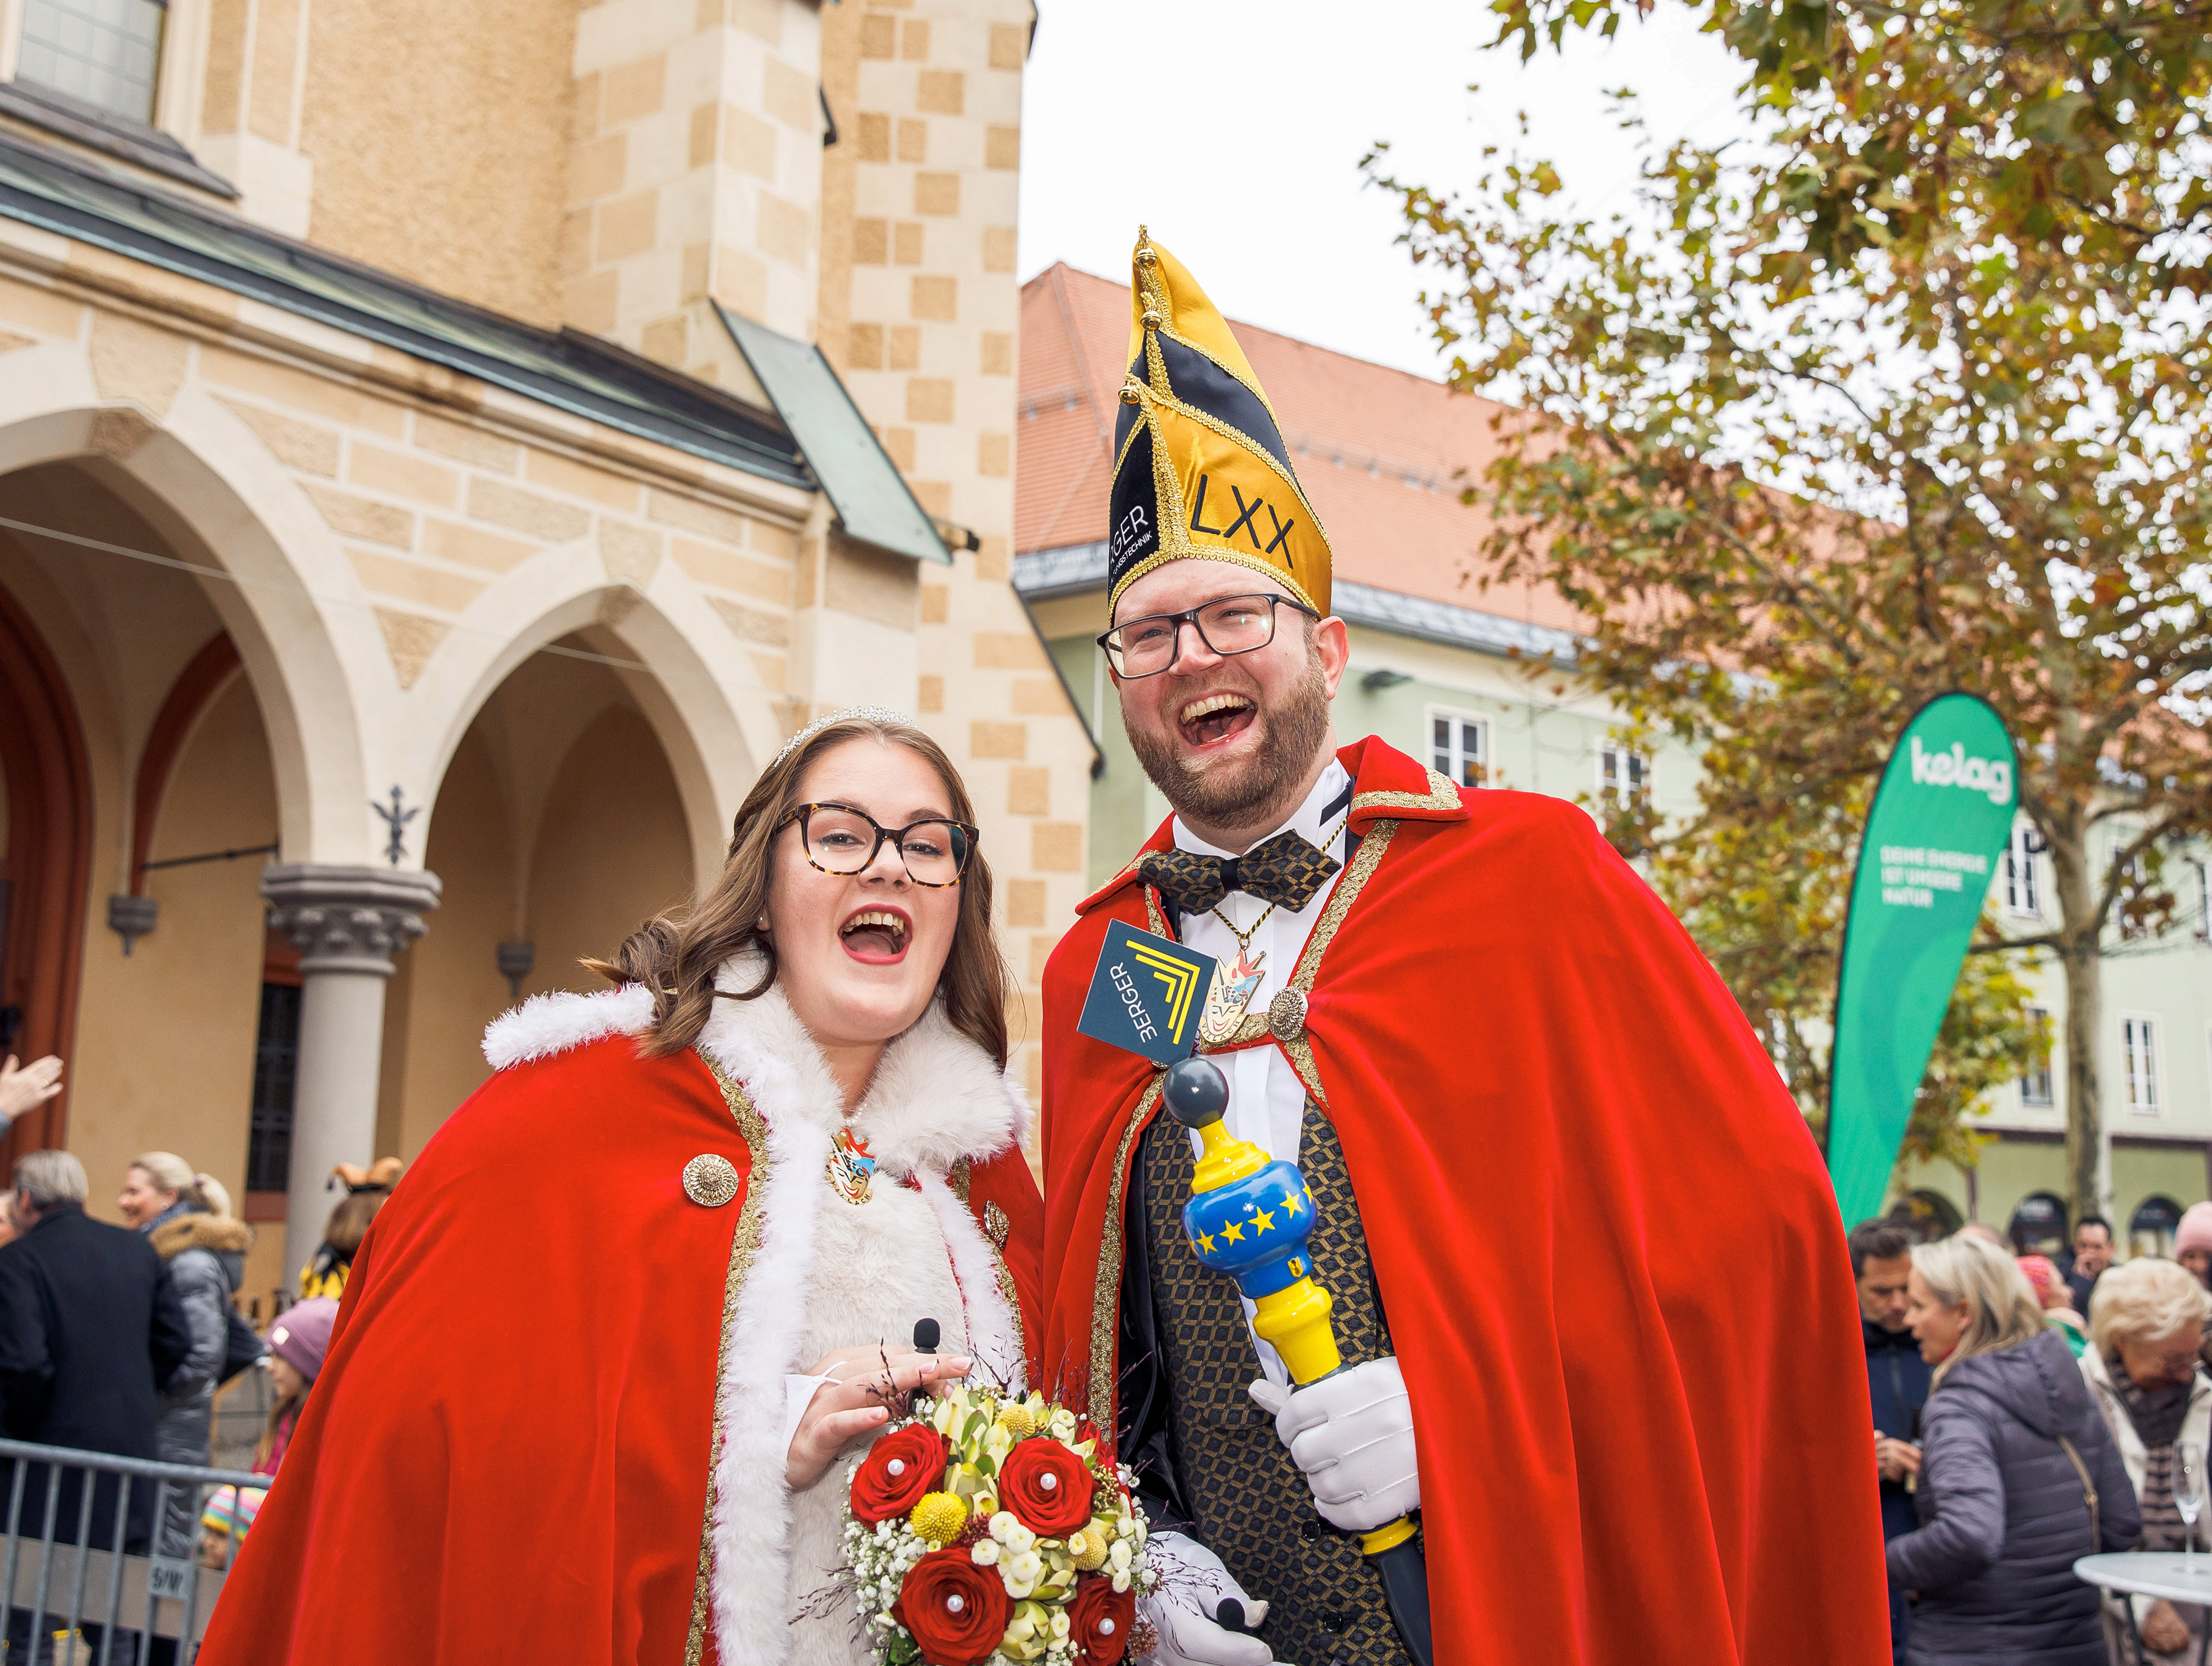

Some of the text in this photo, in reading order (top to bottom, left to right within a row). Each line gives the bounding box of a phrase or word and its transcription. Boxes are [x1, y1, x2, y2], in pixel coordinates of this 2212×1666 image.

[1110, 506, 1149, 566] RGER
[1191, 474, 1294, 570] LXX
[1910, 735, 2012, 806] kelag
[1110, 962, 1158, 1043] BERGER
[1202, 1020, 1240, 1042] VILLACH
